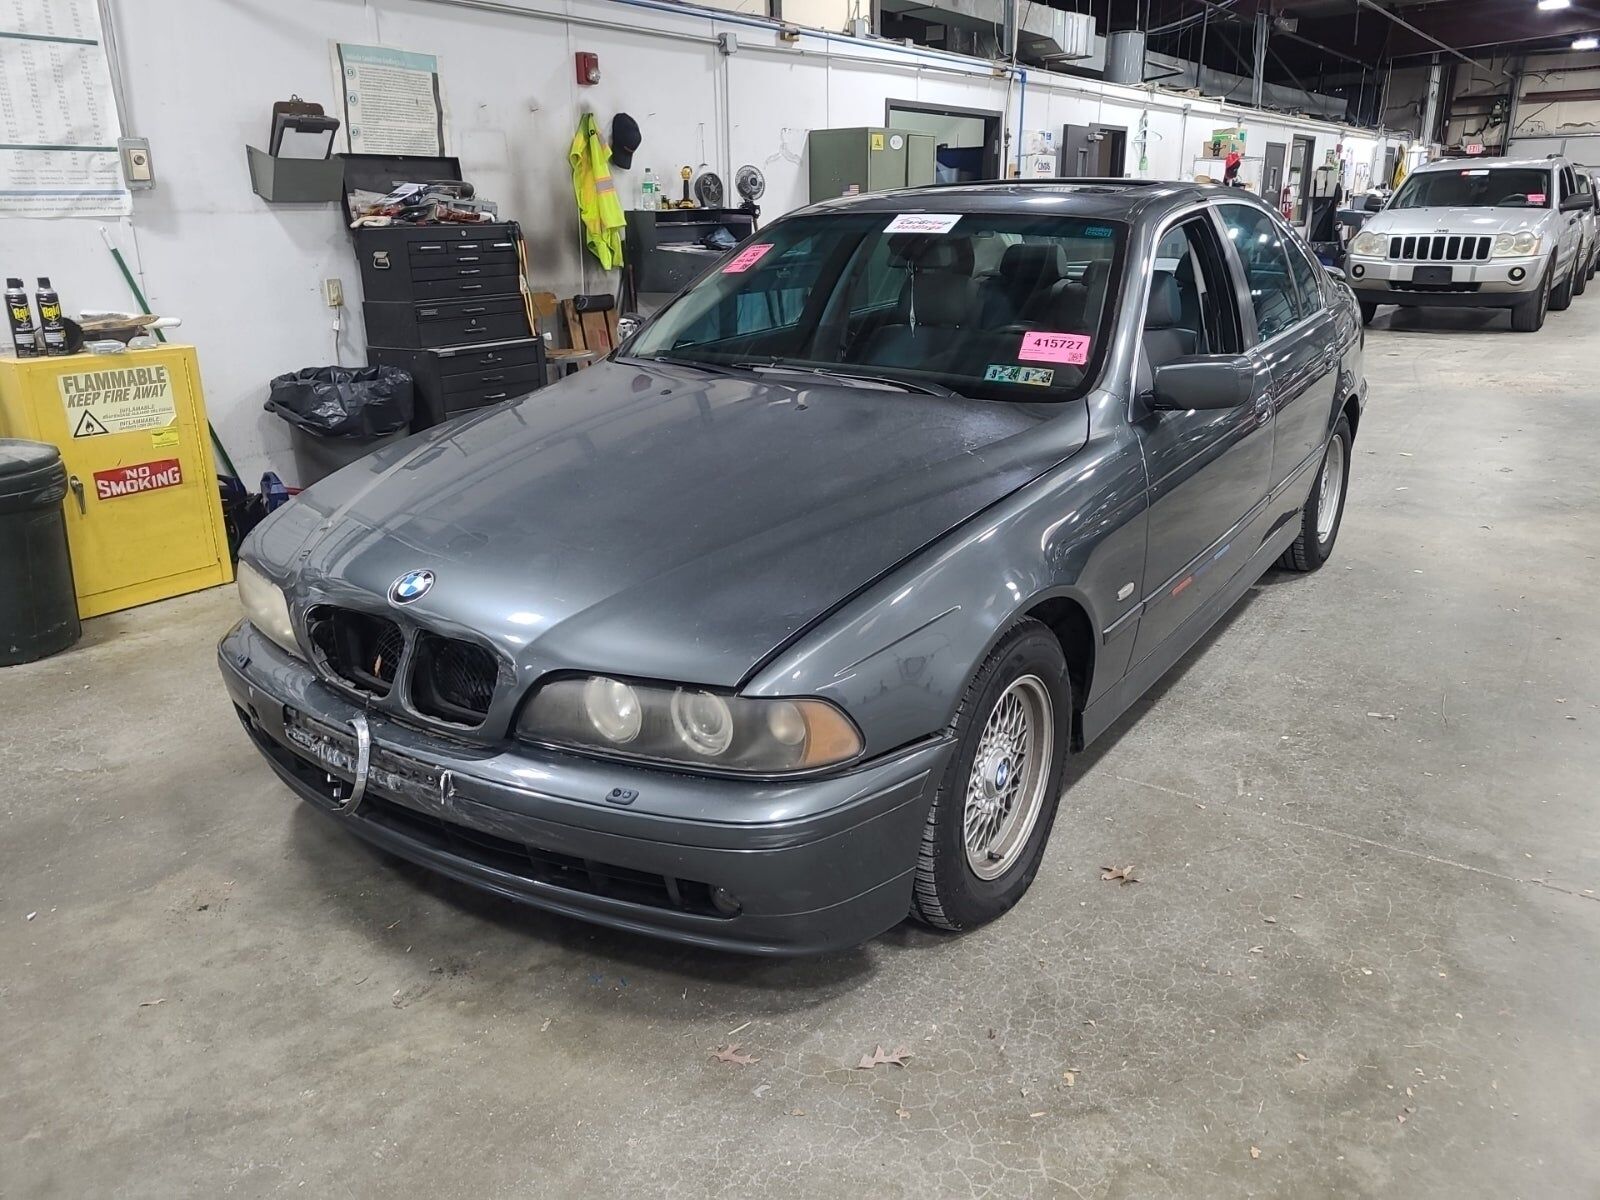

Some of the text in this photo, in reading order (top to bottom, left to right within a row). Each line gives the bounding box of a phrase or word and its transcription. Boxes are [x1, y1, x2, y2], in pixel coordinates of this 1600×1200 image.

[42, 304, 61, 319] Raid
[1034, 338, 1083, 350] 415727
[62, 366, 166, 394] FLAMMABLE
[67, 384, 166, 408] KEEP FIRE AWAY
[97, 467, 180, 498] SMOKING
[126, 466, 150, 480] NO
